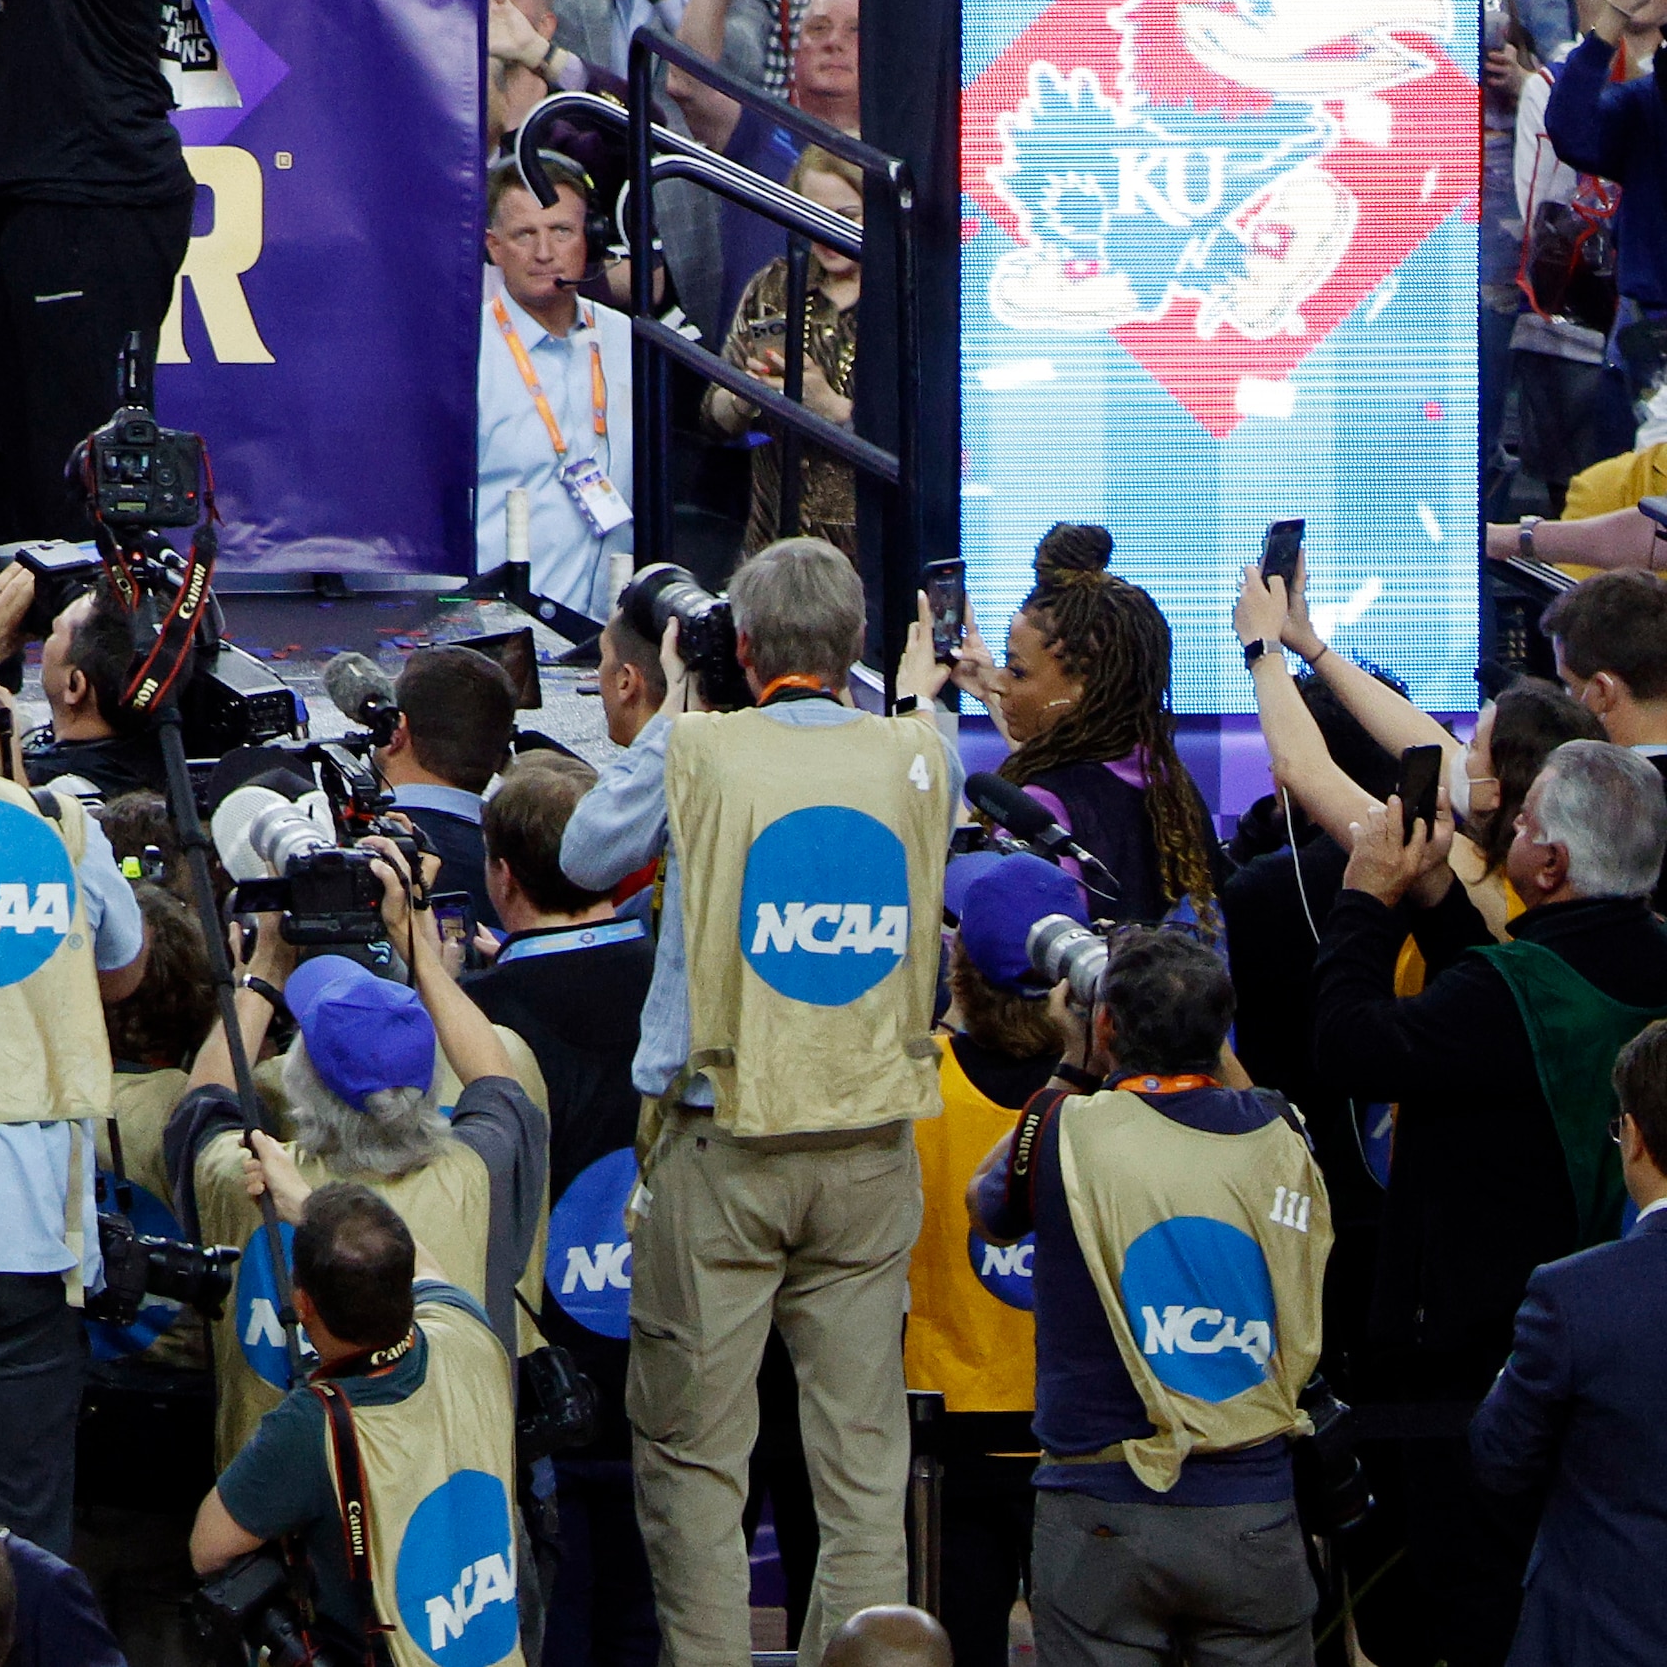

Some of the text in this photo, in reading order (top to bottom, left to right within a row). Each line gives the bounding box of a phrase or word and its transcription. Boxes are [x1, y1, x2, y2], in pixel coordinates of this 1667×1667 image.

[1114, 146, 1227, 228] KU
[178, 563, 206, 619] Canon
[908, 753, 930, 791] 4
[750, 902, 908, 955] NCAA
[1014, 1114, 1040, 1175] Canon
[1269, 1186, 1311, 1233] 111
[561, 1242, 633, 1294] NC
[981, 1244, 1035, 1277] NC
[1142, 1304, 1270, 1364] NCAA
[348, 1500, 364, 1556] Canon
[424, 1550, 517, 1651] NCA
